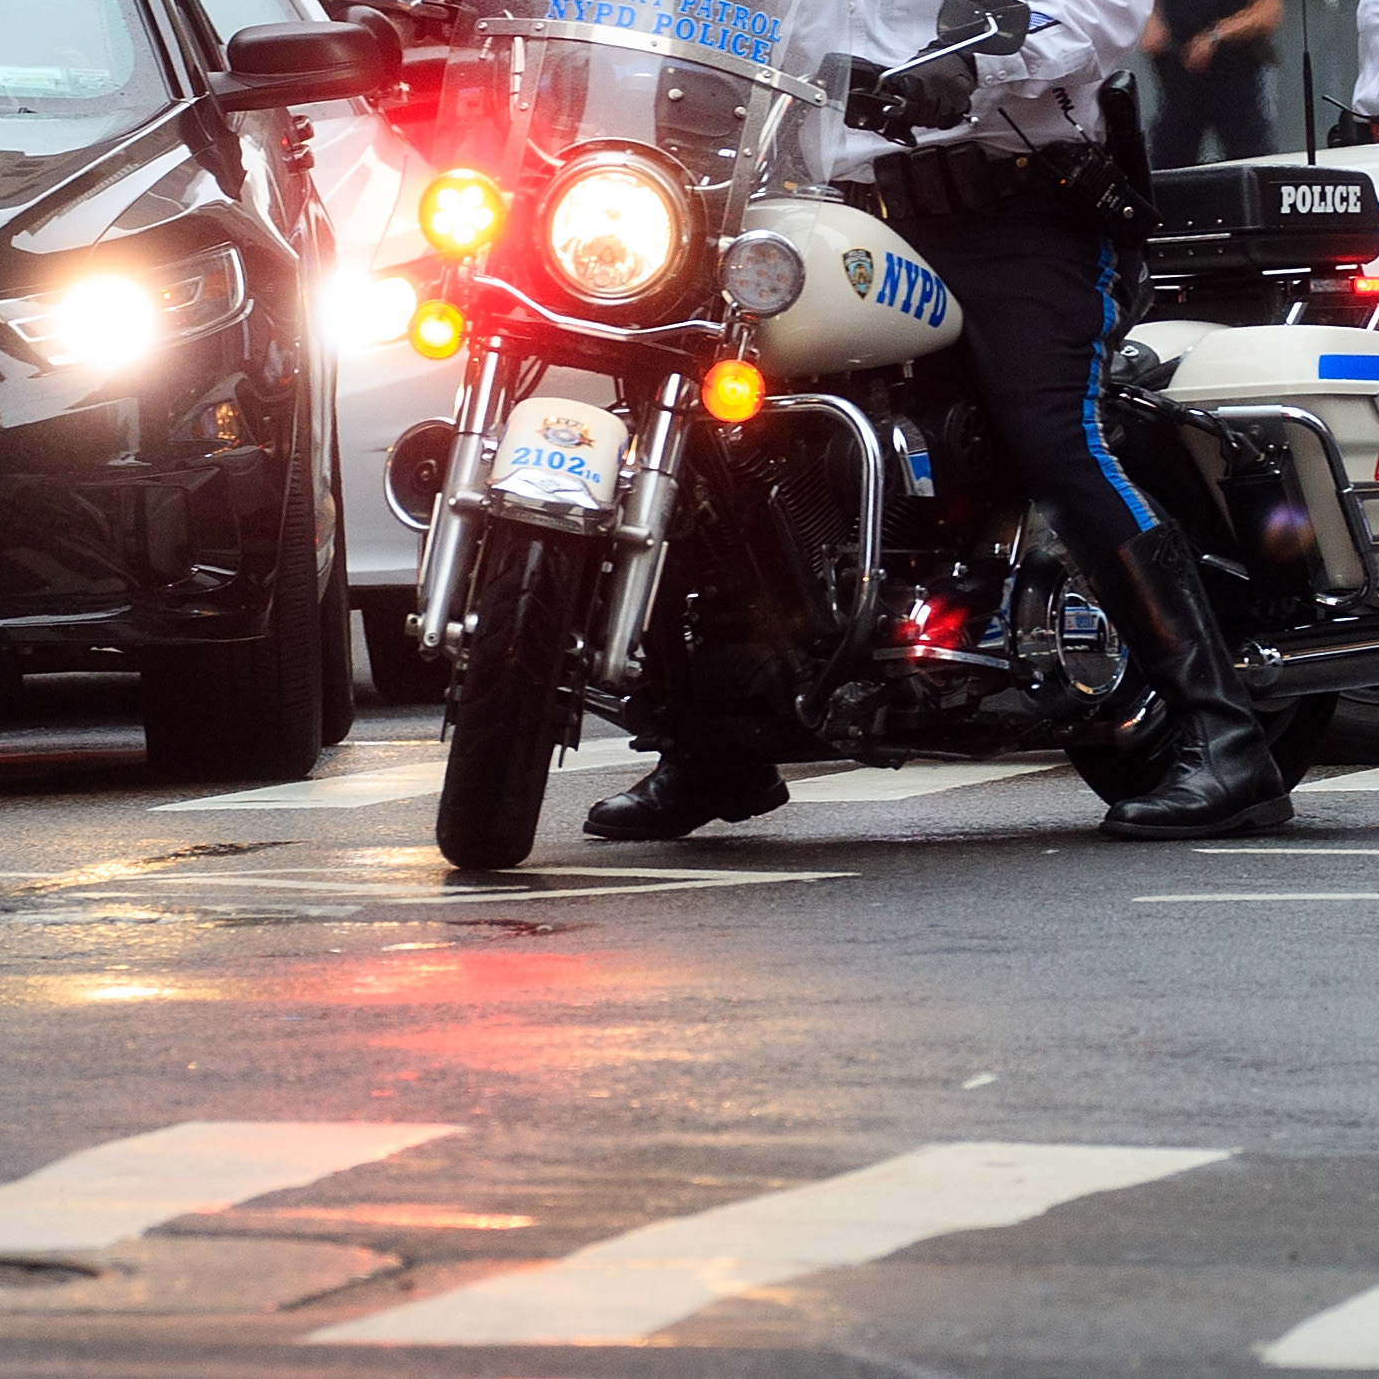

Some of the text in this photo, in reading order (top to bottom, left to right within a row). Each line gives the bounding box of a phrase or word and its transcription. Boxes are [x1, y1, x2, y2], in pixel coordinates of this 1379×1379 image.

[652, 13, 772, 64] POLICE
[1280, 185, 1361, 213] POLICE
[876, 252, 947, 328] NYPD
[511, 447, 586, 477] 2102
